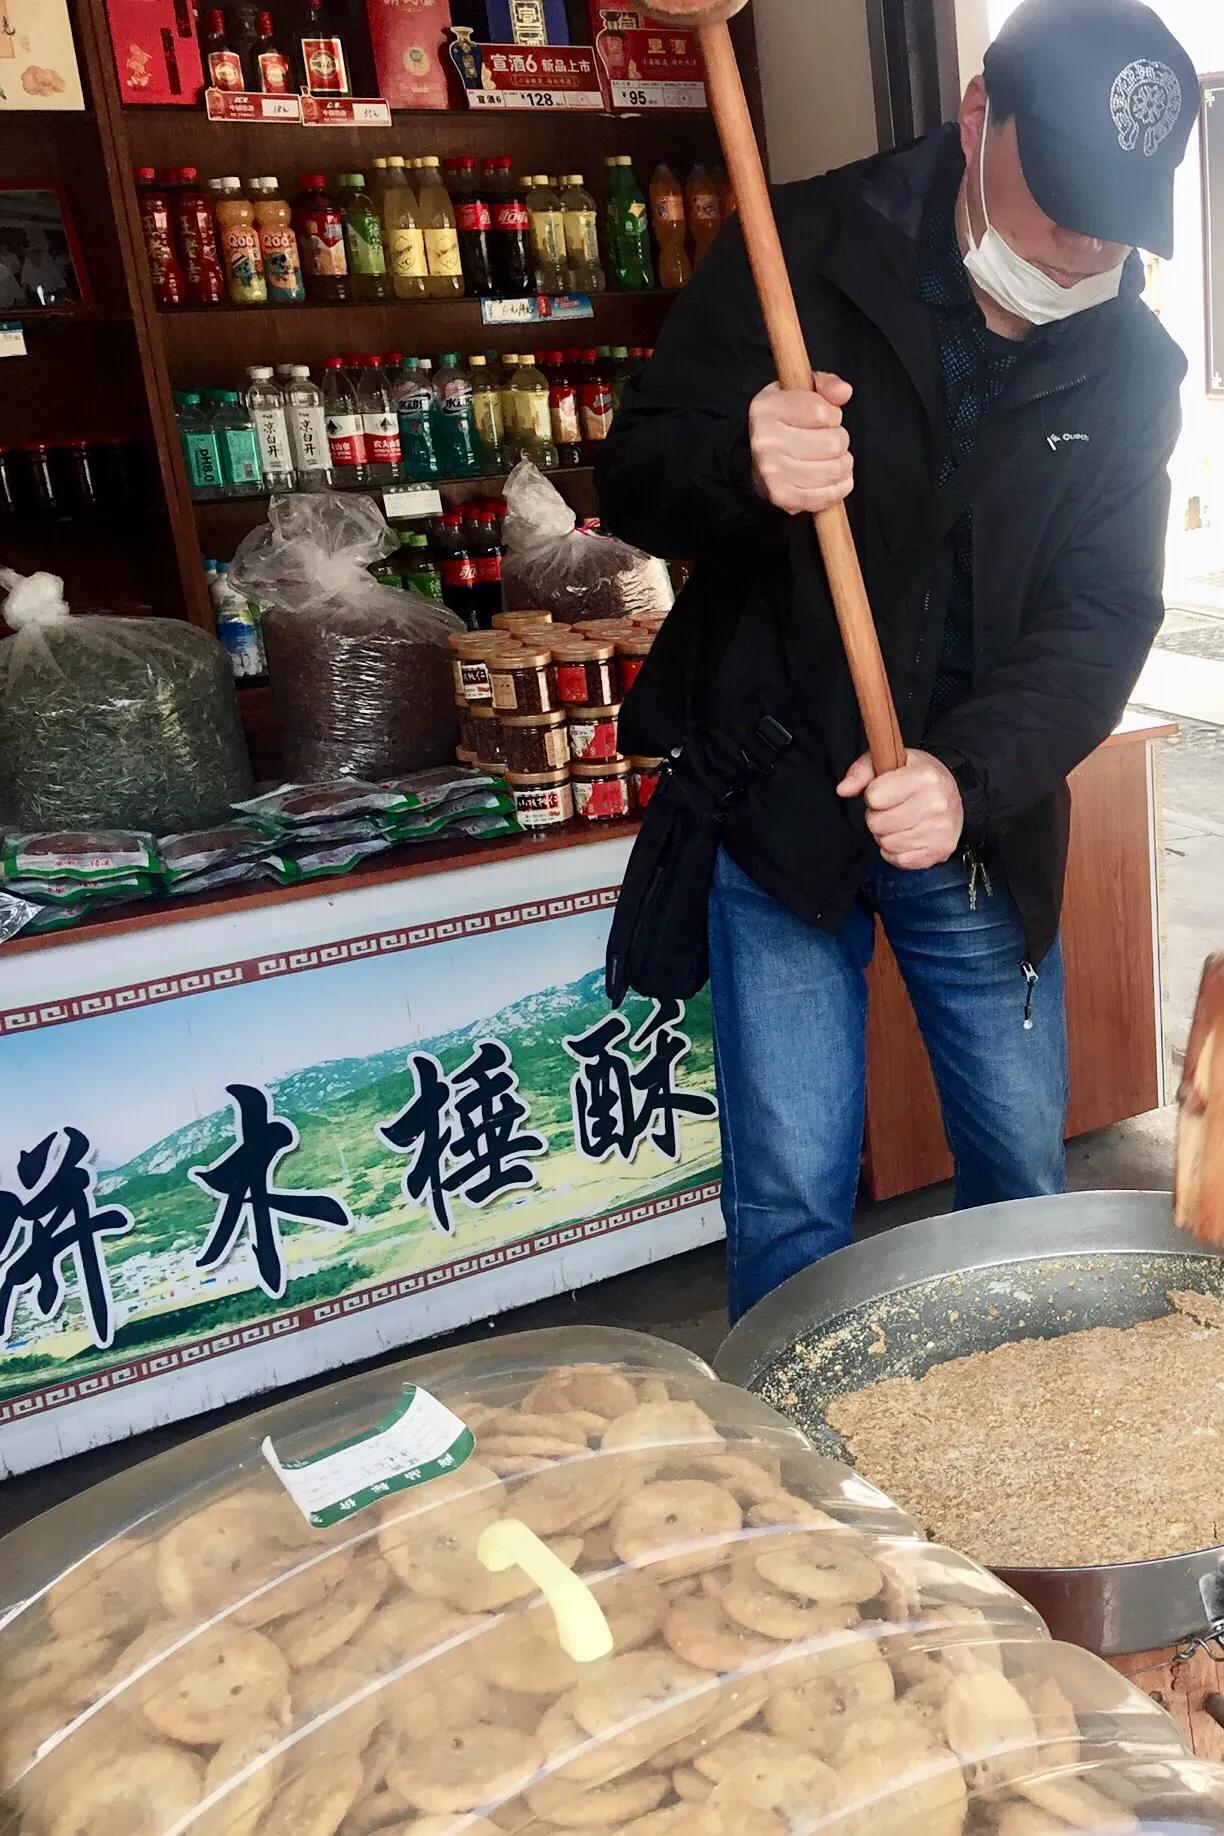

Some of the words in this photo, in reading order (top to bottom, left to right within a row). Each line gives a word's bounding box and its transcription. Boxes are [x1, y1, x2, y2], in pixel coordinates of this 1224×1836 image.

[490, 53, 538, 73] 宣酒6
[541, 59, 591, 73] 新品上市
[521, 92, 553, 107] ¥128
[621, 90, 647, 105] ¥95
[198, 448, 215, 482] pH8.0
